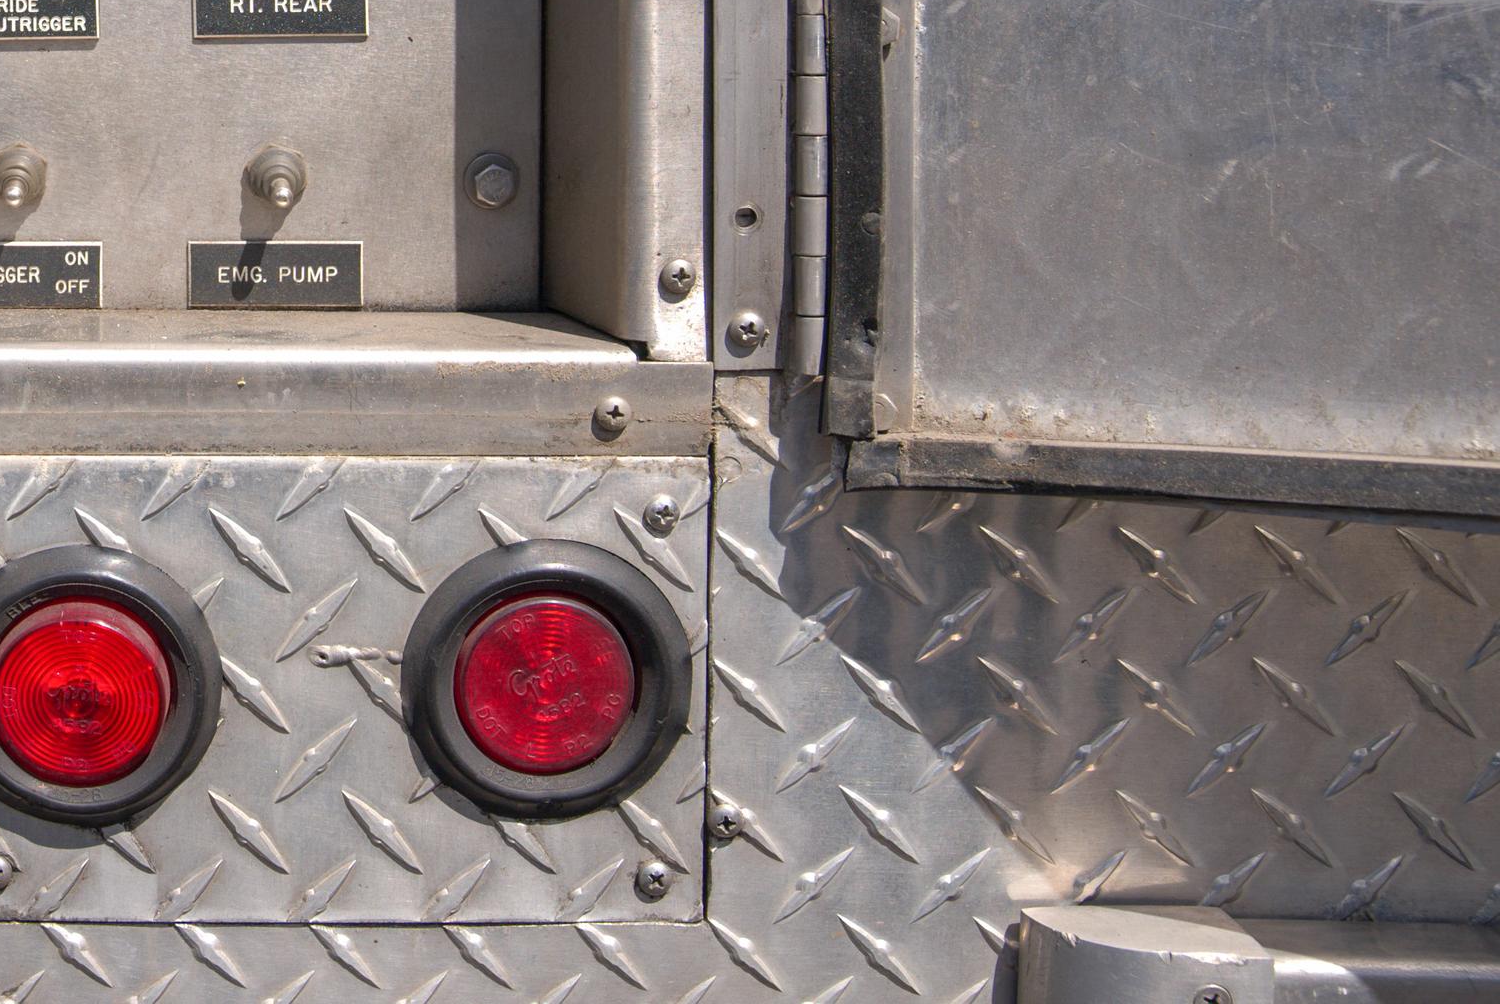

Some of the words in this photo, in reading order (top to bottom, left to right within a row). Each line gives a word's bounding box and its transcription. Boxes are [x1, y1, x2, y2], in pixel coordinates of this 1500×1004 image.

[64, 251, 89, 266] ON
[218, 266, 268, 284] EMG.
[278, 266, 338, 284] PUMP
[55, 279, 90, 294] OFF
[495, 613, 535, 640] TOP
